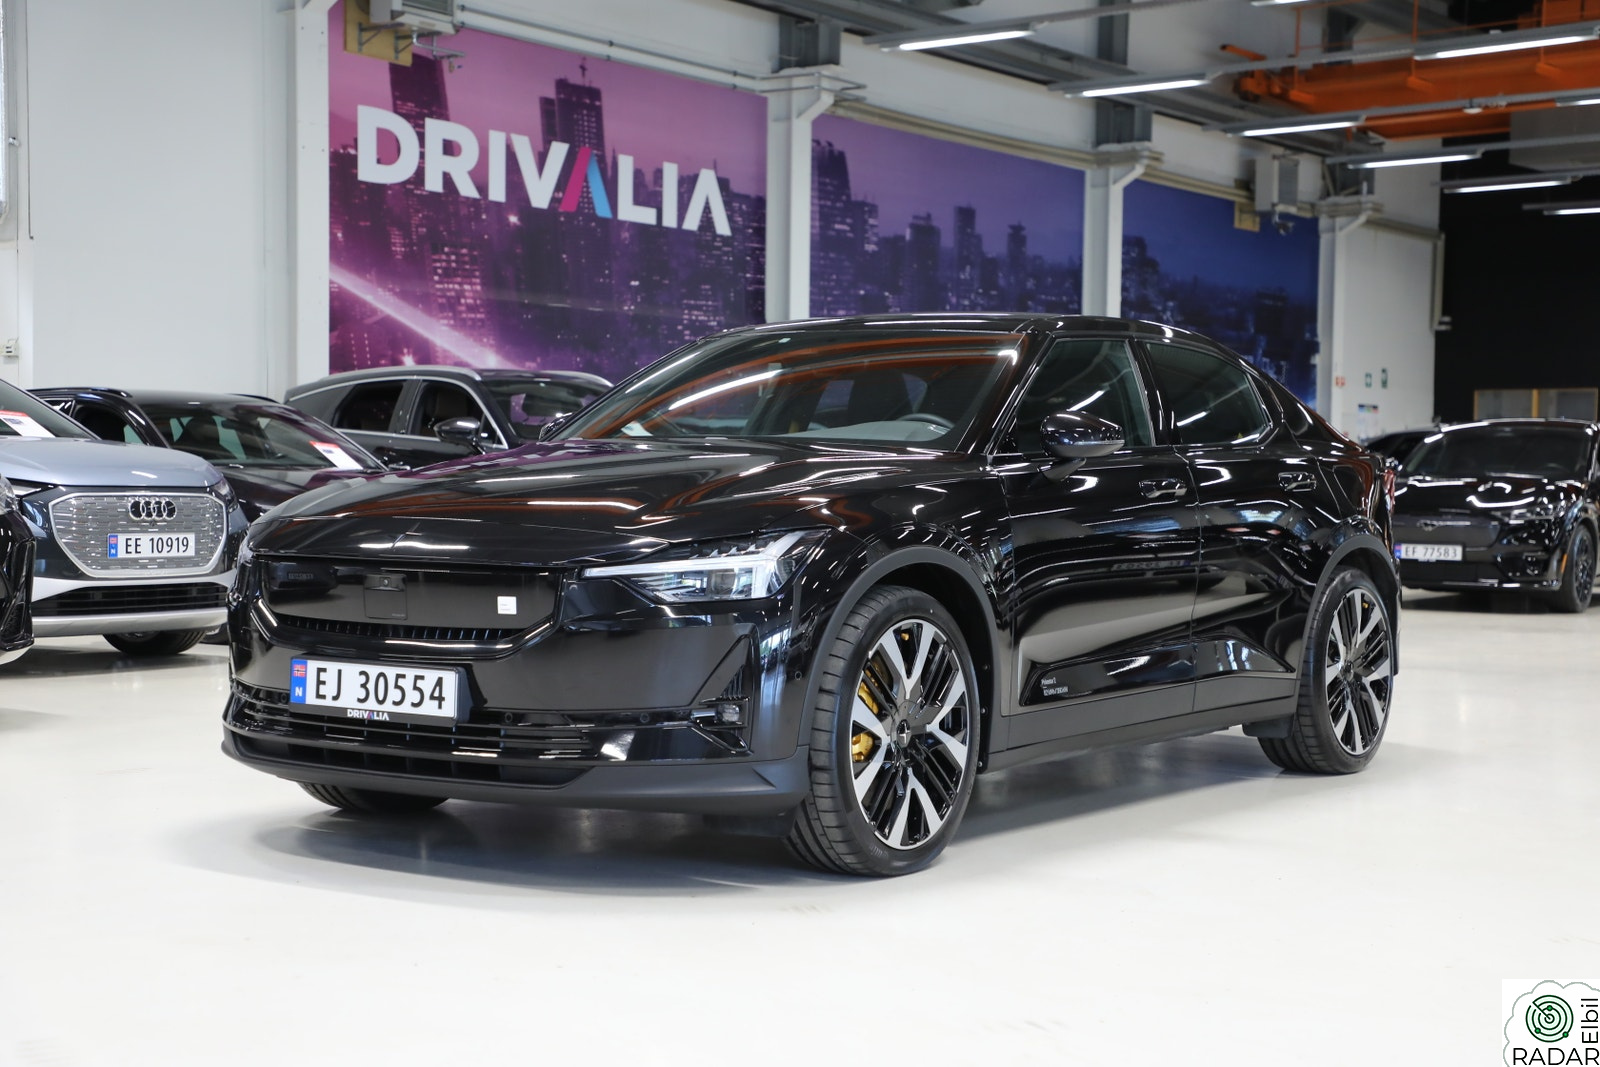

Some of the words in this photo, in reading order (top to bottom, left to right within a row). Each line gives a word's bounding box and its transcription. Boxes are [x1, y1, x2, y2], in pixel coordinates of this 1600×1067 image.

[357, 104, 732, 236] DRIVALIA
[125, 538, 141, 554] EE
[149, 537, 189, 553] 10919
[1405, 546, 1417, 557] EF
[1423, 546, 1457, 558] 77583
[295, 687, 303, 697] N
[315, 667, 342, 701] EJ
[357, 670, 445, 710] 30554
[347, 709, 389, 721] DRIVALIA
